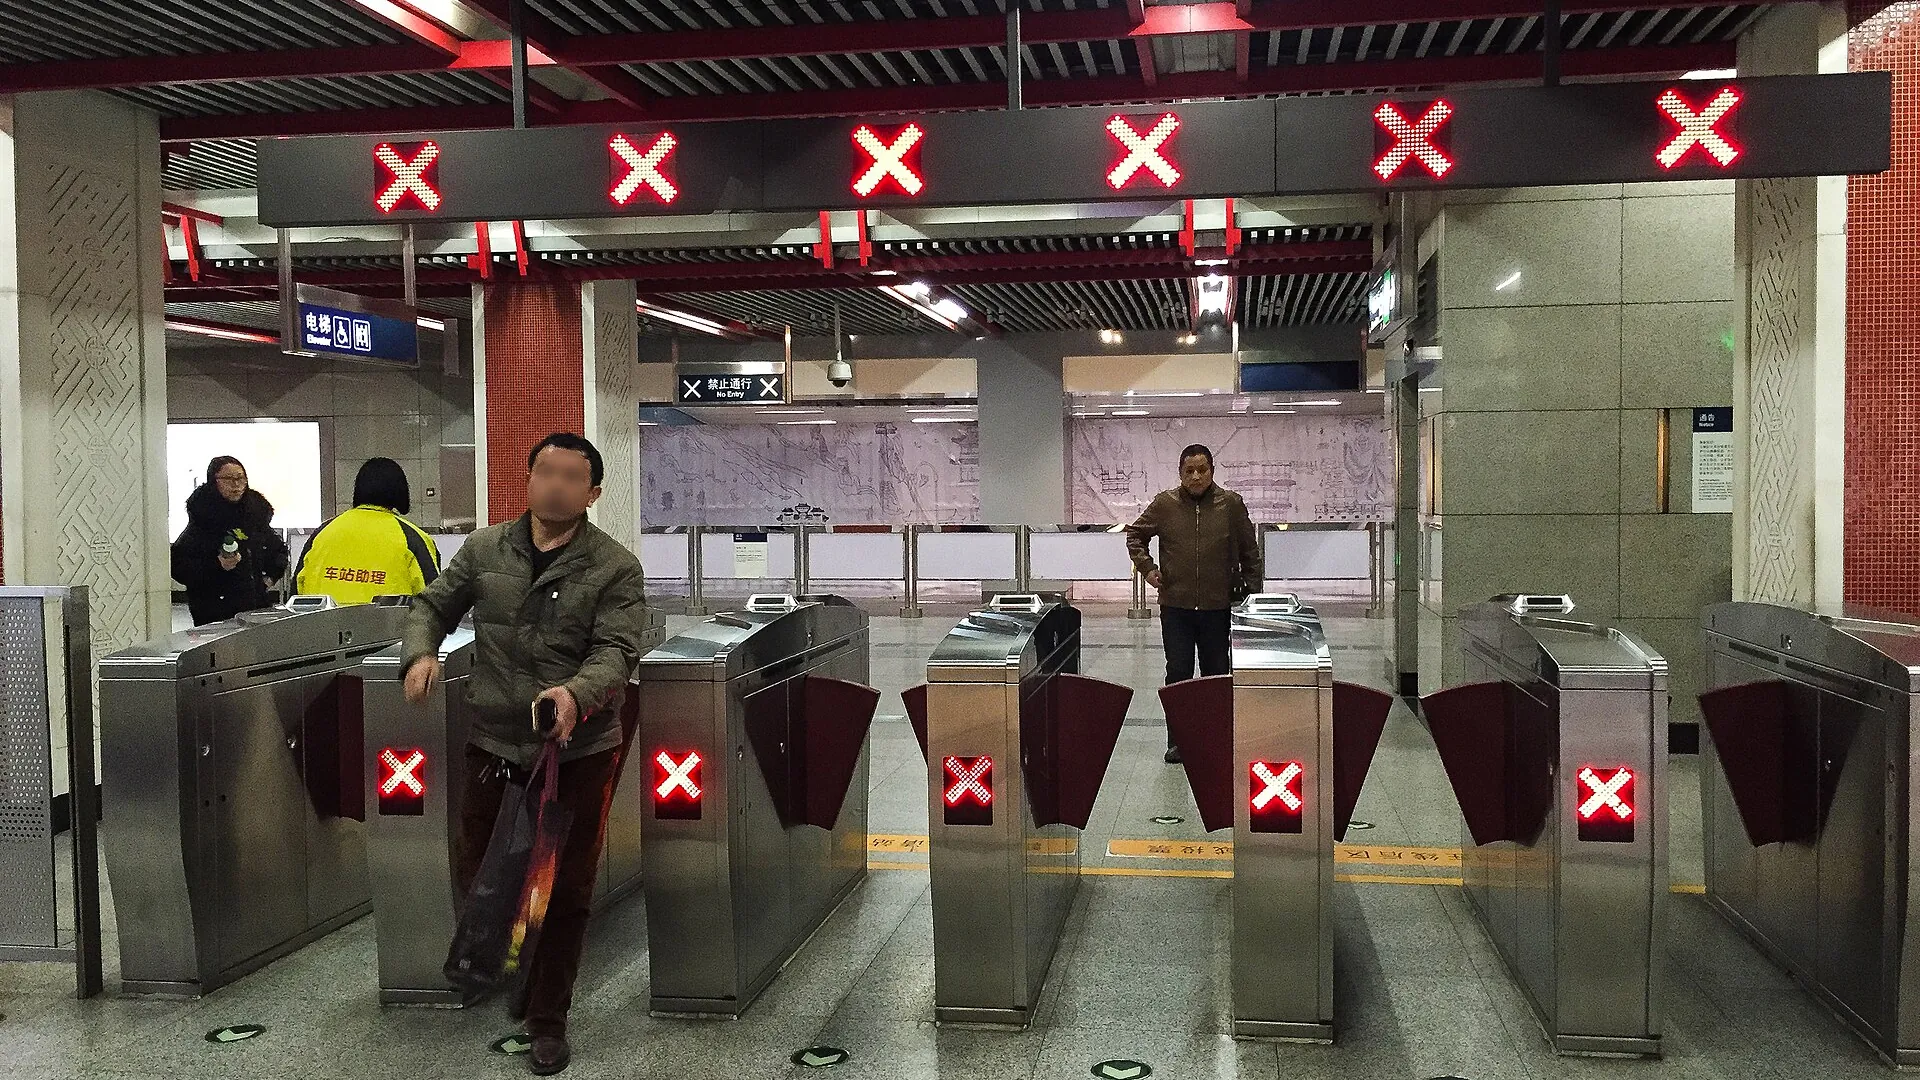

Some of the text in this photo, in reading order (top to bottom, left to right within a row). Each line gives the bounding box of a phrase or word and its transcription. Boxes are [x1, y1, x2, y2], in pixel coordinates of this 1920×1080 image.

[306, 312, 331, 334] 电梯
[707, 377, 752, 390] 禁止通行
[727, 390, 745, 398] Entry
[324, 566, 386, 585] 车站助理
